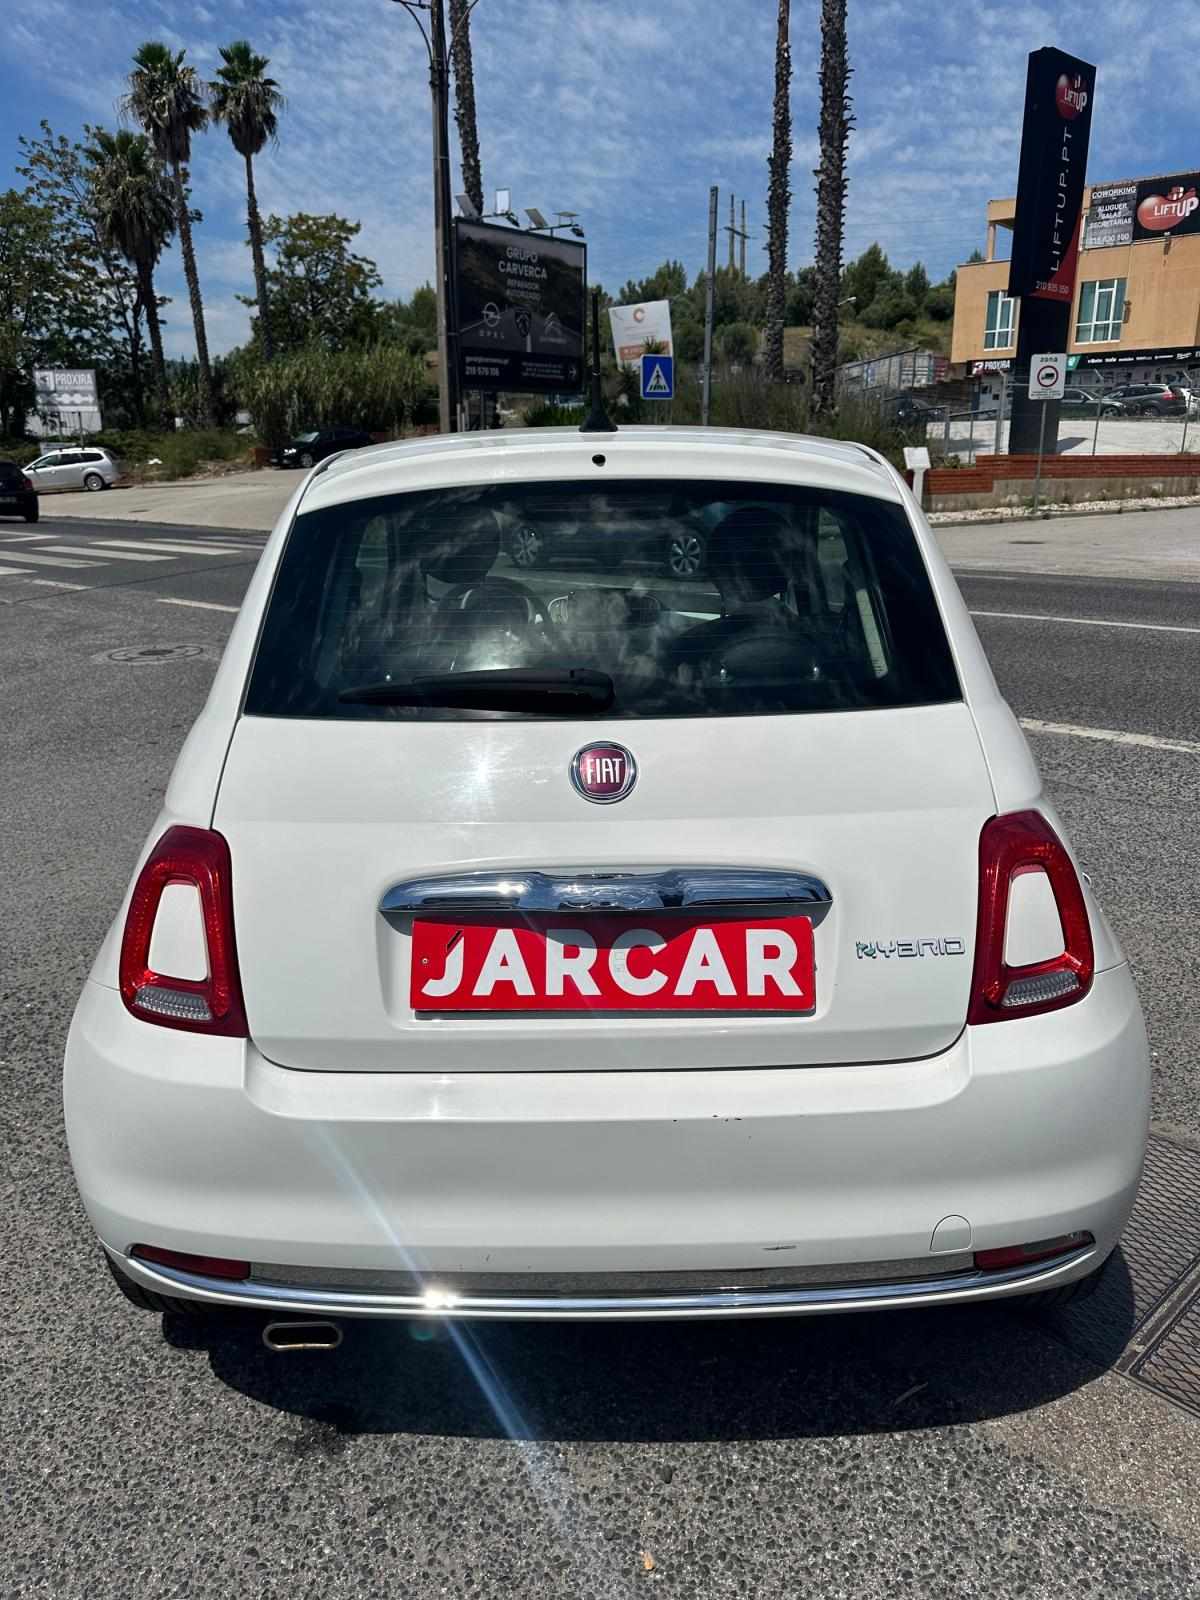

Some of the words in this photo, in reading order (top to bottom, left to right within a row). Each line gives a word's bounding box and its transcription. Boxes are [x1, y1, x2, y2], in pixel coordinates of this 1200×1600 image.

[1064, 88, 1088, 112] LIFTUP
[1050, 126, 1073, 272] LIFTUP.PT
[1092, 186, 1137, 199] COWORKING
[1154, 196, 1200, 217] LIFTUP
[506, 247, 539, 263] GRUPO
[498, 260, 548, 279] CARVERCA
[55, 374, 93, 385] PROXIRA
[586, 757, 622, 785] FIAT
[855, 936, 966, 959] HYBRID
[421, 928, 805, 997] JARCAR
